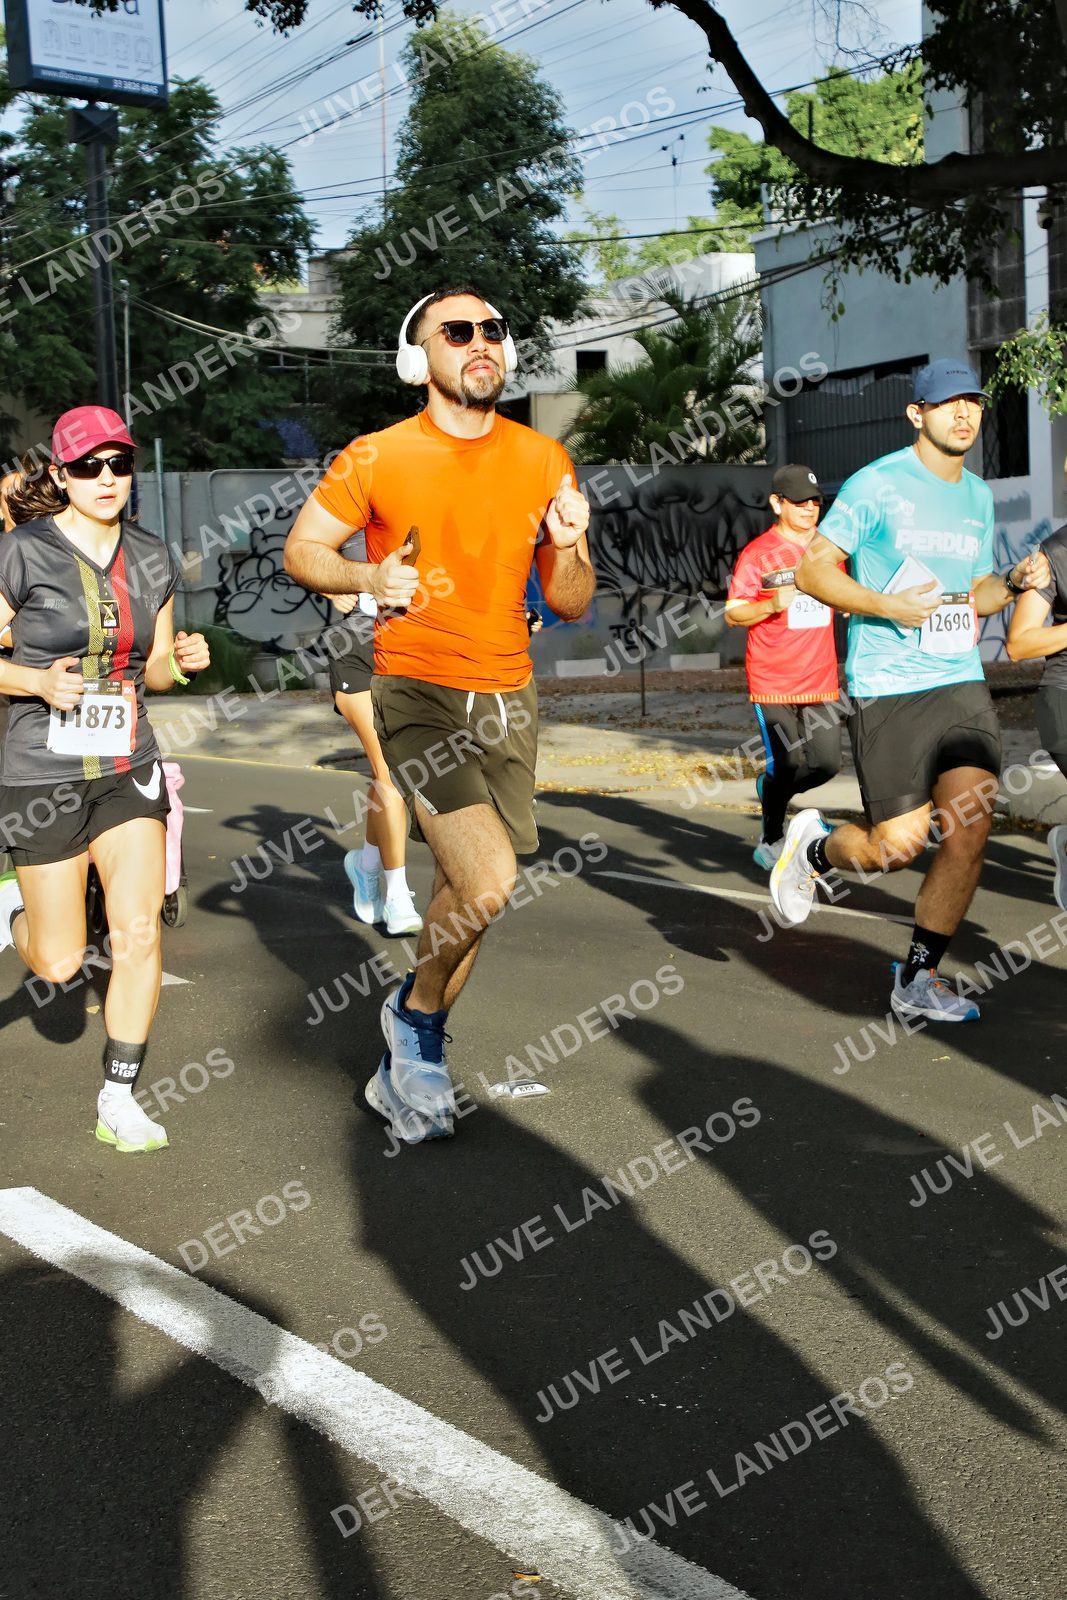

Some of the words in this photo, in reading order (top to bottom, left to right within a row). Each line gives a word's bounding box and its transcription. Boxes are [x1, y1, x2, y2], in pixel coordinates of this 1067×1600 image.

[895, 528, 982, 558] PERDUR
[929, 612, 971, 633] 12690
[56, 704, 126, 729] 11873
